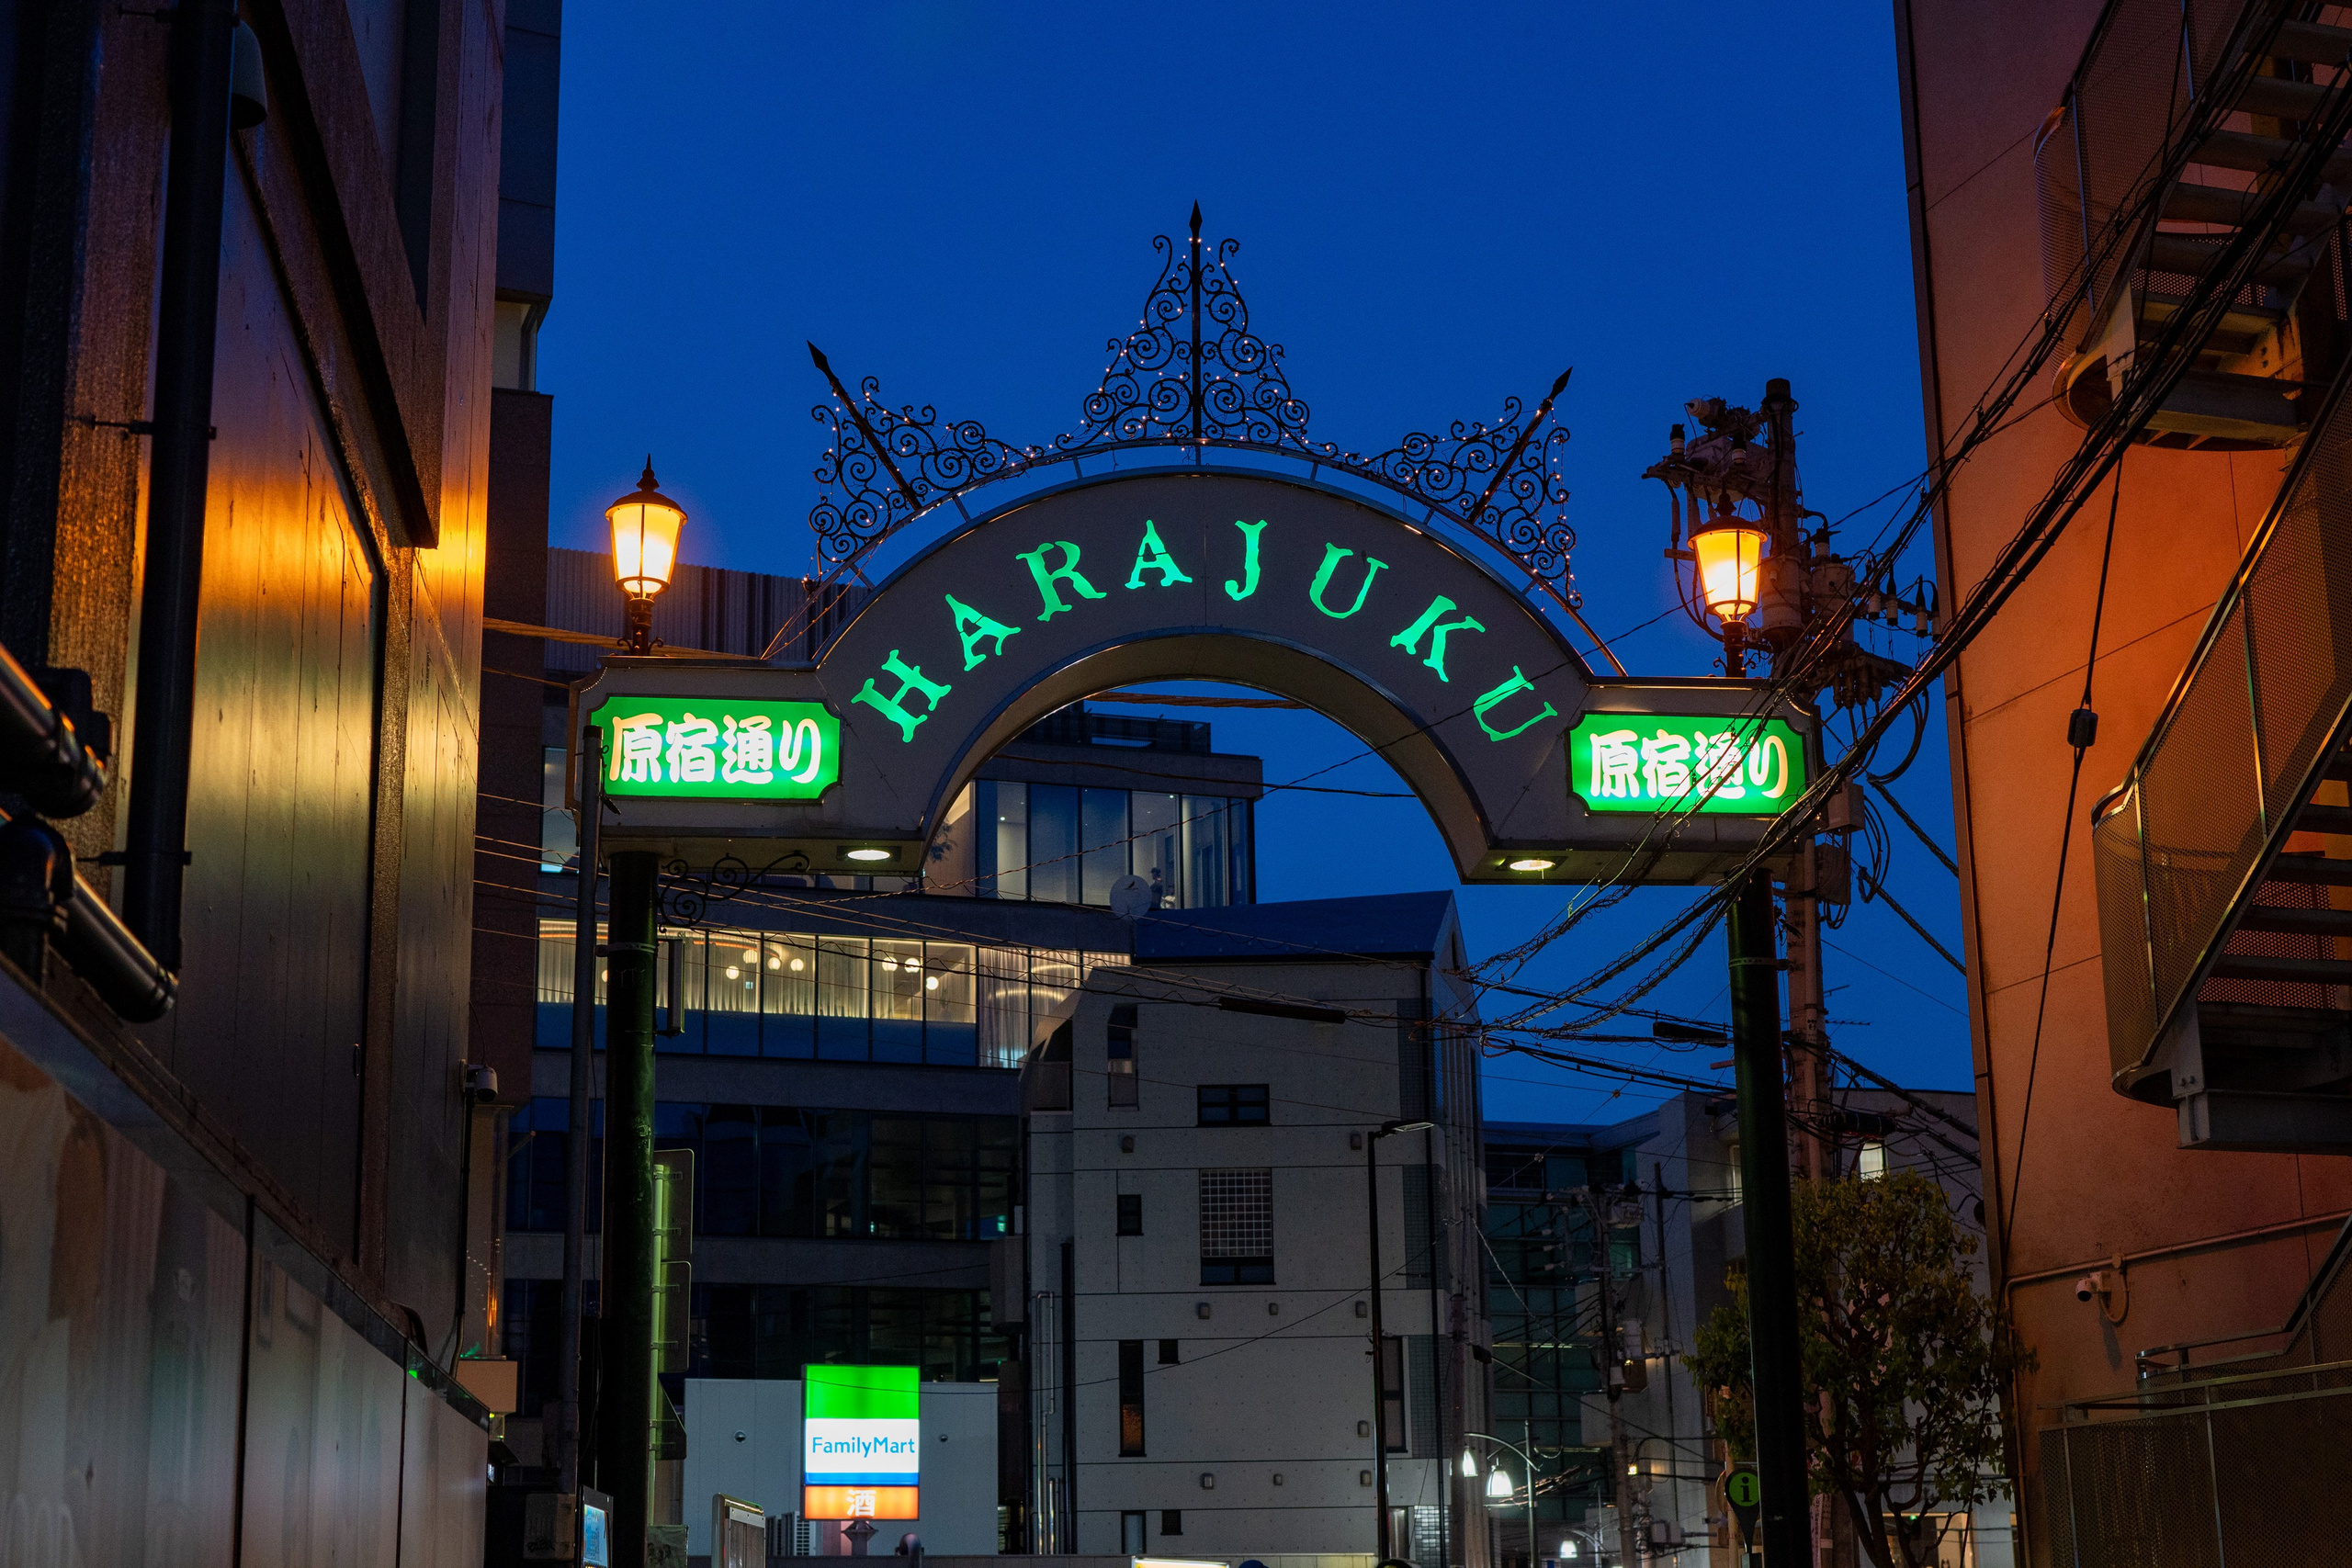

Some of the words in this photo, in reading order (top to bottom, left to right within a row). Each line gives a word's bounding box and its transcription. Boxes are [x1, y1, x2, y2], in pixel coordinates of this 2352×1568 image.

[851, 519, 1558, 743] HARAJUKU
[609, 712, 822, 784] 原宿通り
[1589, 728, 1789, 800] 原宿通り
[812, 1437, 915, 1458] FamilyMart
[846, 1489, 876, 1517] 酒
